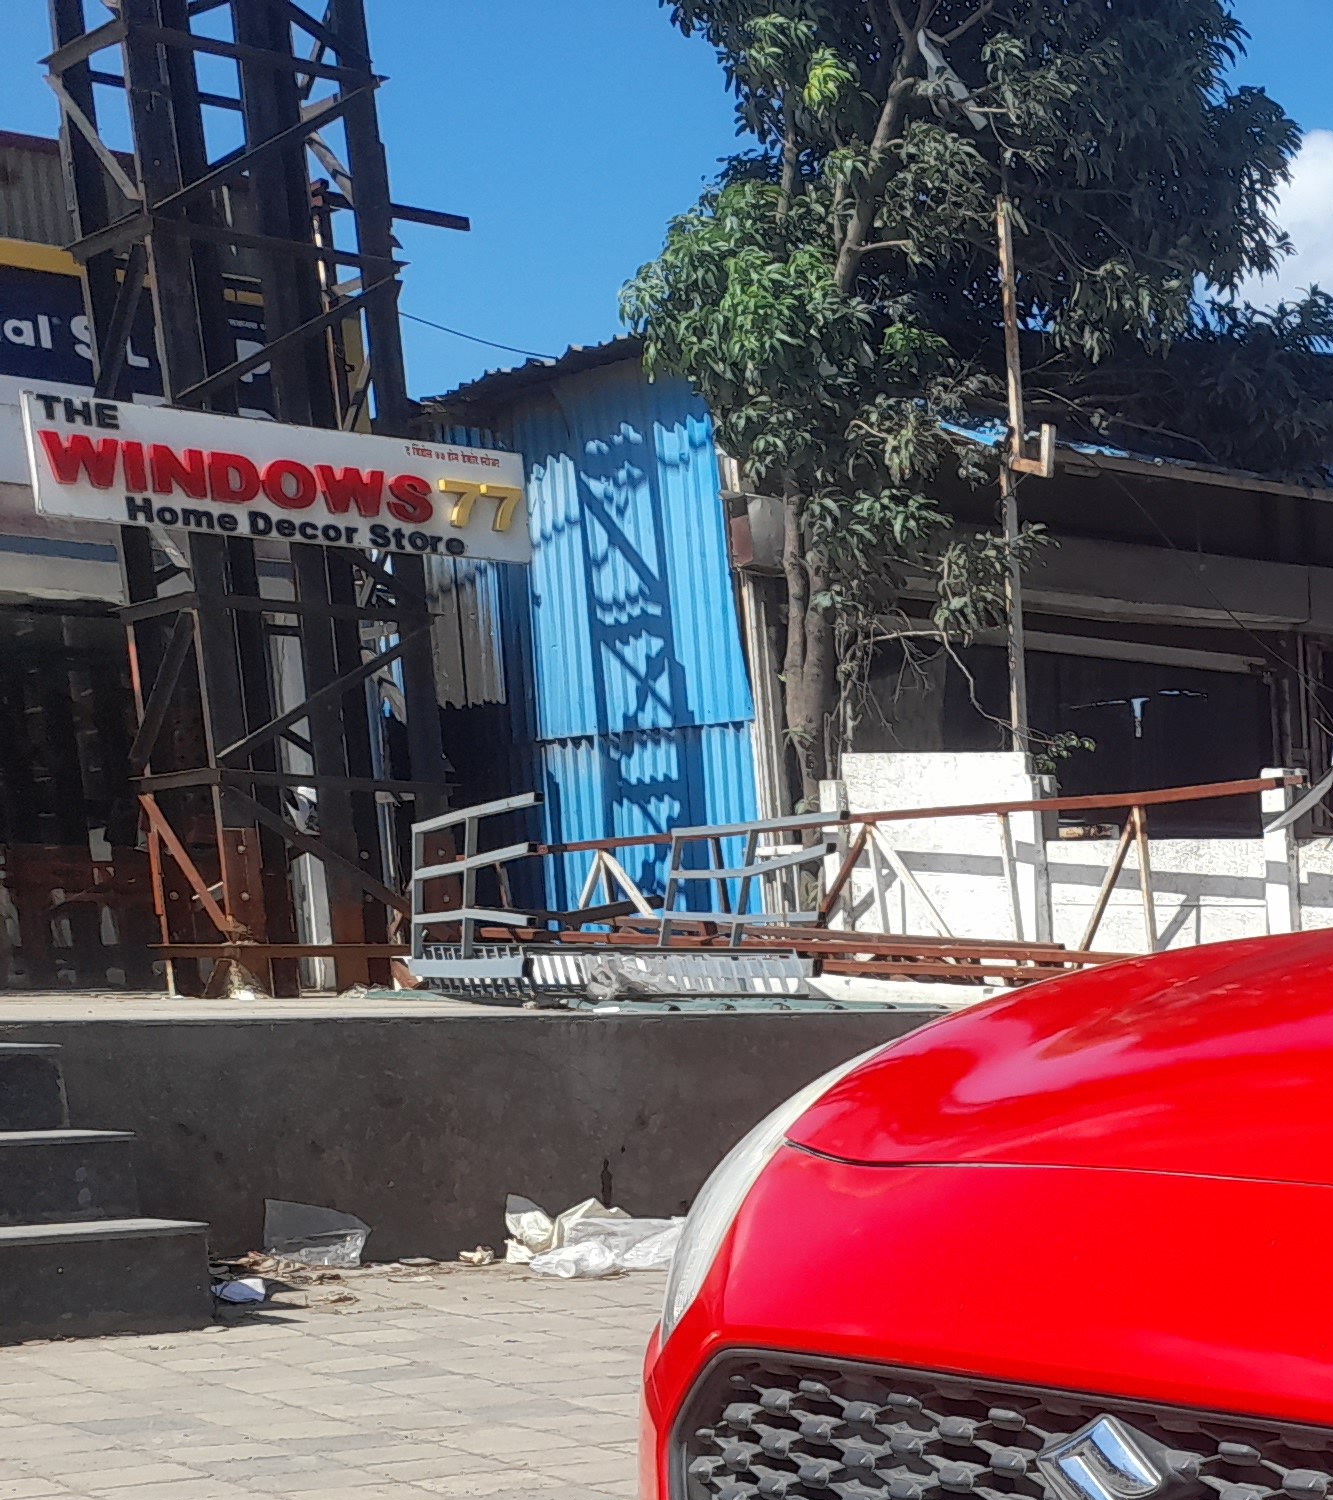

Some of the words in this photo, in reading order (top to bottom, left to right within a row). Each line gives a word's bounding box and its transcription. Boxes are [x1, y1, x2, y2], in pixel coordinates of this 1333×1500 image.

[0, 314, 52, 350] al
[35, 393, 120, 430] THE
[37, 429, 433, 524] WINDOWS
[438, 478, 523, 532] 77
[125, 496, 239, 532] Home
[249, 511, 358, 544] Decor
[369, 523, 466, 556] Store
